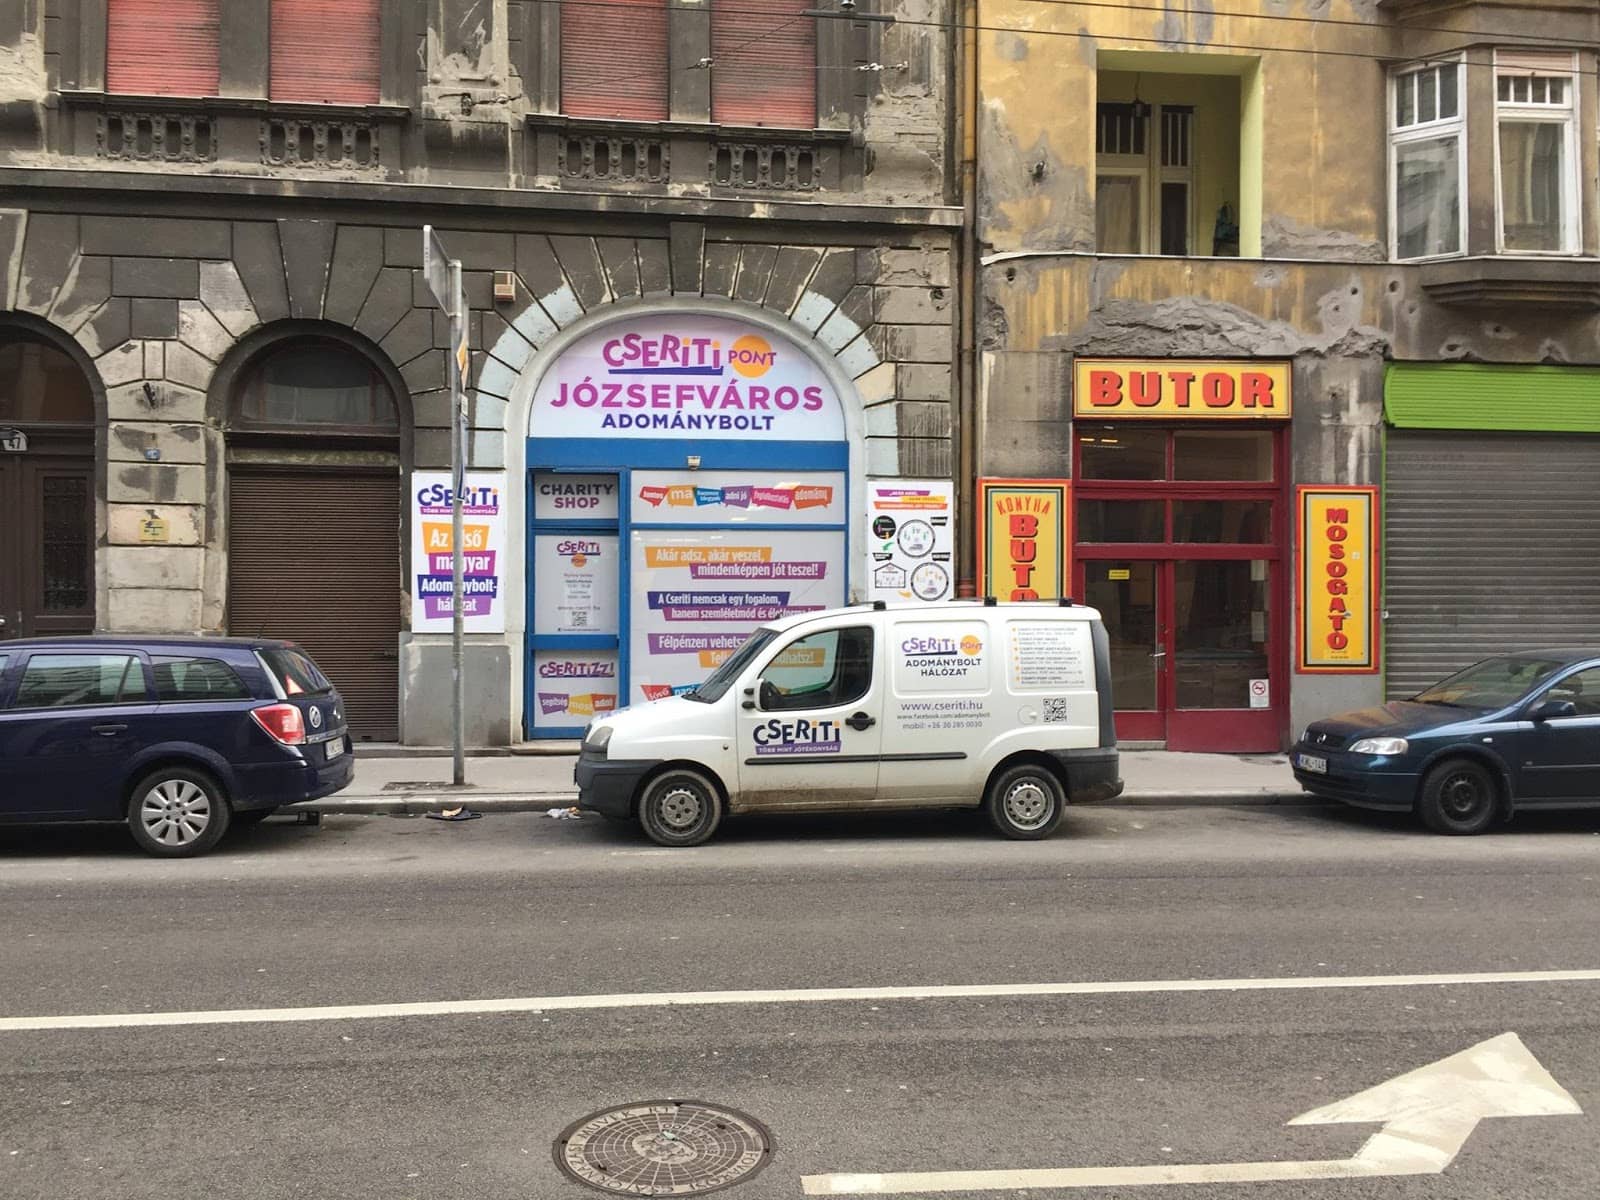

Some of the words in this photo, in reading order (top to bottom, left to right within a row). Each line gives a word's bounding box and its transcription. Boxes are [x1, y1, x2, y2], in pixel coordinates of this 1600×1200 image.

[728, 350, 777, 367] PONT
[550, 376, 824, 411] JÓZSEFVÁROS
[1089, 371, 1275, 408] BUTOR
[601, 411, 775, 431] ADOMÁNYBOLT
[540, 484, 614, 496] CHARITY
[554, 497, 600, 509] SHOP
[996, 496, 1051, 515] KONYHA
[430, 528, 449, 547] Az
[656, 549, 678, 561] Akár
[680, 550, 706, 563] adsz,
[708, 549, 730, 561] akár
[732, 550, 764, 563] veszel,
[698, 563, 770, 578] mindenképpen
[771, 563, 786, 578] jót
[787, 563, 819, 576] teszel!
[422, 578, 498, 594] Adomybolt-
[437, 598, 477, 612] hálzat
[658, 594, 665, 605] A
[666, 593, 691, 605] Cseriti
[692, 594, 727, 605] nemcsak
[729, 595, 743, 607] egy
[745, 594, 782, 607] fogalom,
[671, 608, 699, 619] hanem
[700, 607, 756, 619] szemléletmód
[758, 607, 767, 619] és
[659, 635, 708, 650] Félpénzen
[960, 642, 983, 650] PONT
[905, 657, 982, 667] ADOMÁNYBOLT
[921, 668, 968, 677] HÁLÓZAT
[901, 700, 983, 711] www.cseriti.hu
